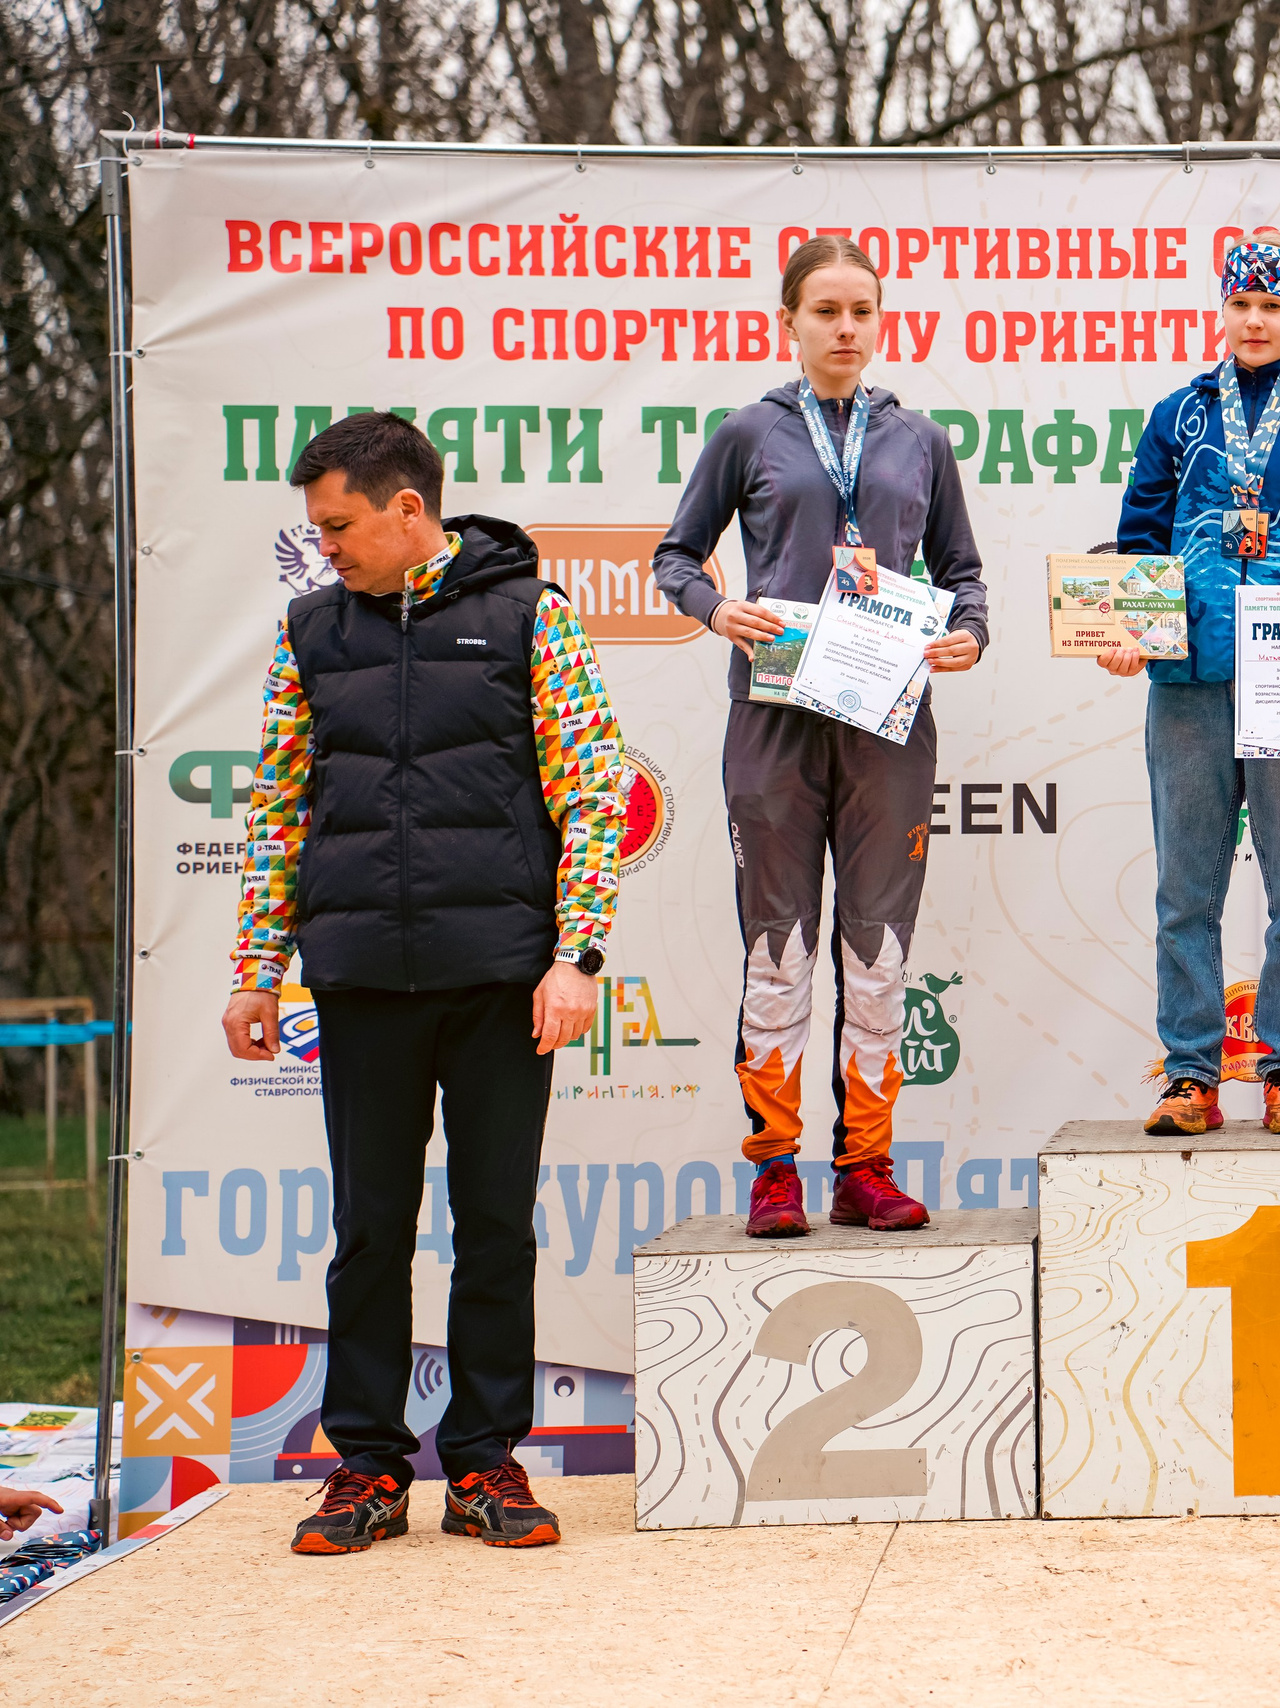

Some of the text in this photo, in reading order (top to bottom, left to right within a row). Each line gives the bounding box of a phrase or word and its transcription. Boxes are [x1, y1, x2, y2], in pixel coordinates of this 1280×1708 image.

[225, 213, 752, 279] ВСЕРОССИЙСКИЕ
[778, 226, 1187, 279] СОРТИВНЫЕ
[387, 307, 465, 361] ПО
[222, 405, 603, 484] ПАЯТИ
[838, 592, 913, 627] ГРАМОТА
[1122, 600, 1176, 609] РАХАТ-ЛУКУМ
[456, 638, 487, 646] STROBBS
[1074, 640, 1122, 648] ПЯТИГОРСКА
[756, 673, 793, 686] ПЯТИГО
[622, 744, 667, 783] ДЕРАЦИЯ
[646, 785, 675, 862] СПОРТИВНОГО
[230, 1075, 304, 1086] ФИЗИЧЕСКОЙ
[746, 1281, 928, 1502] 2
